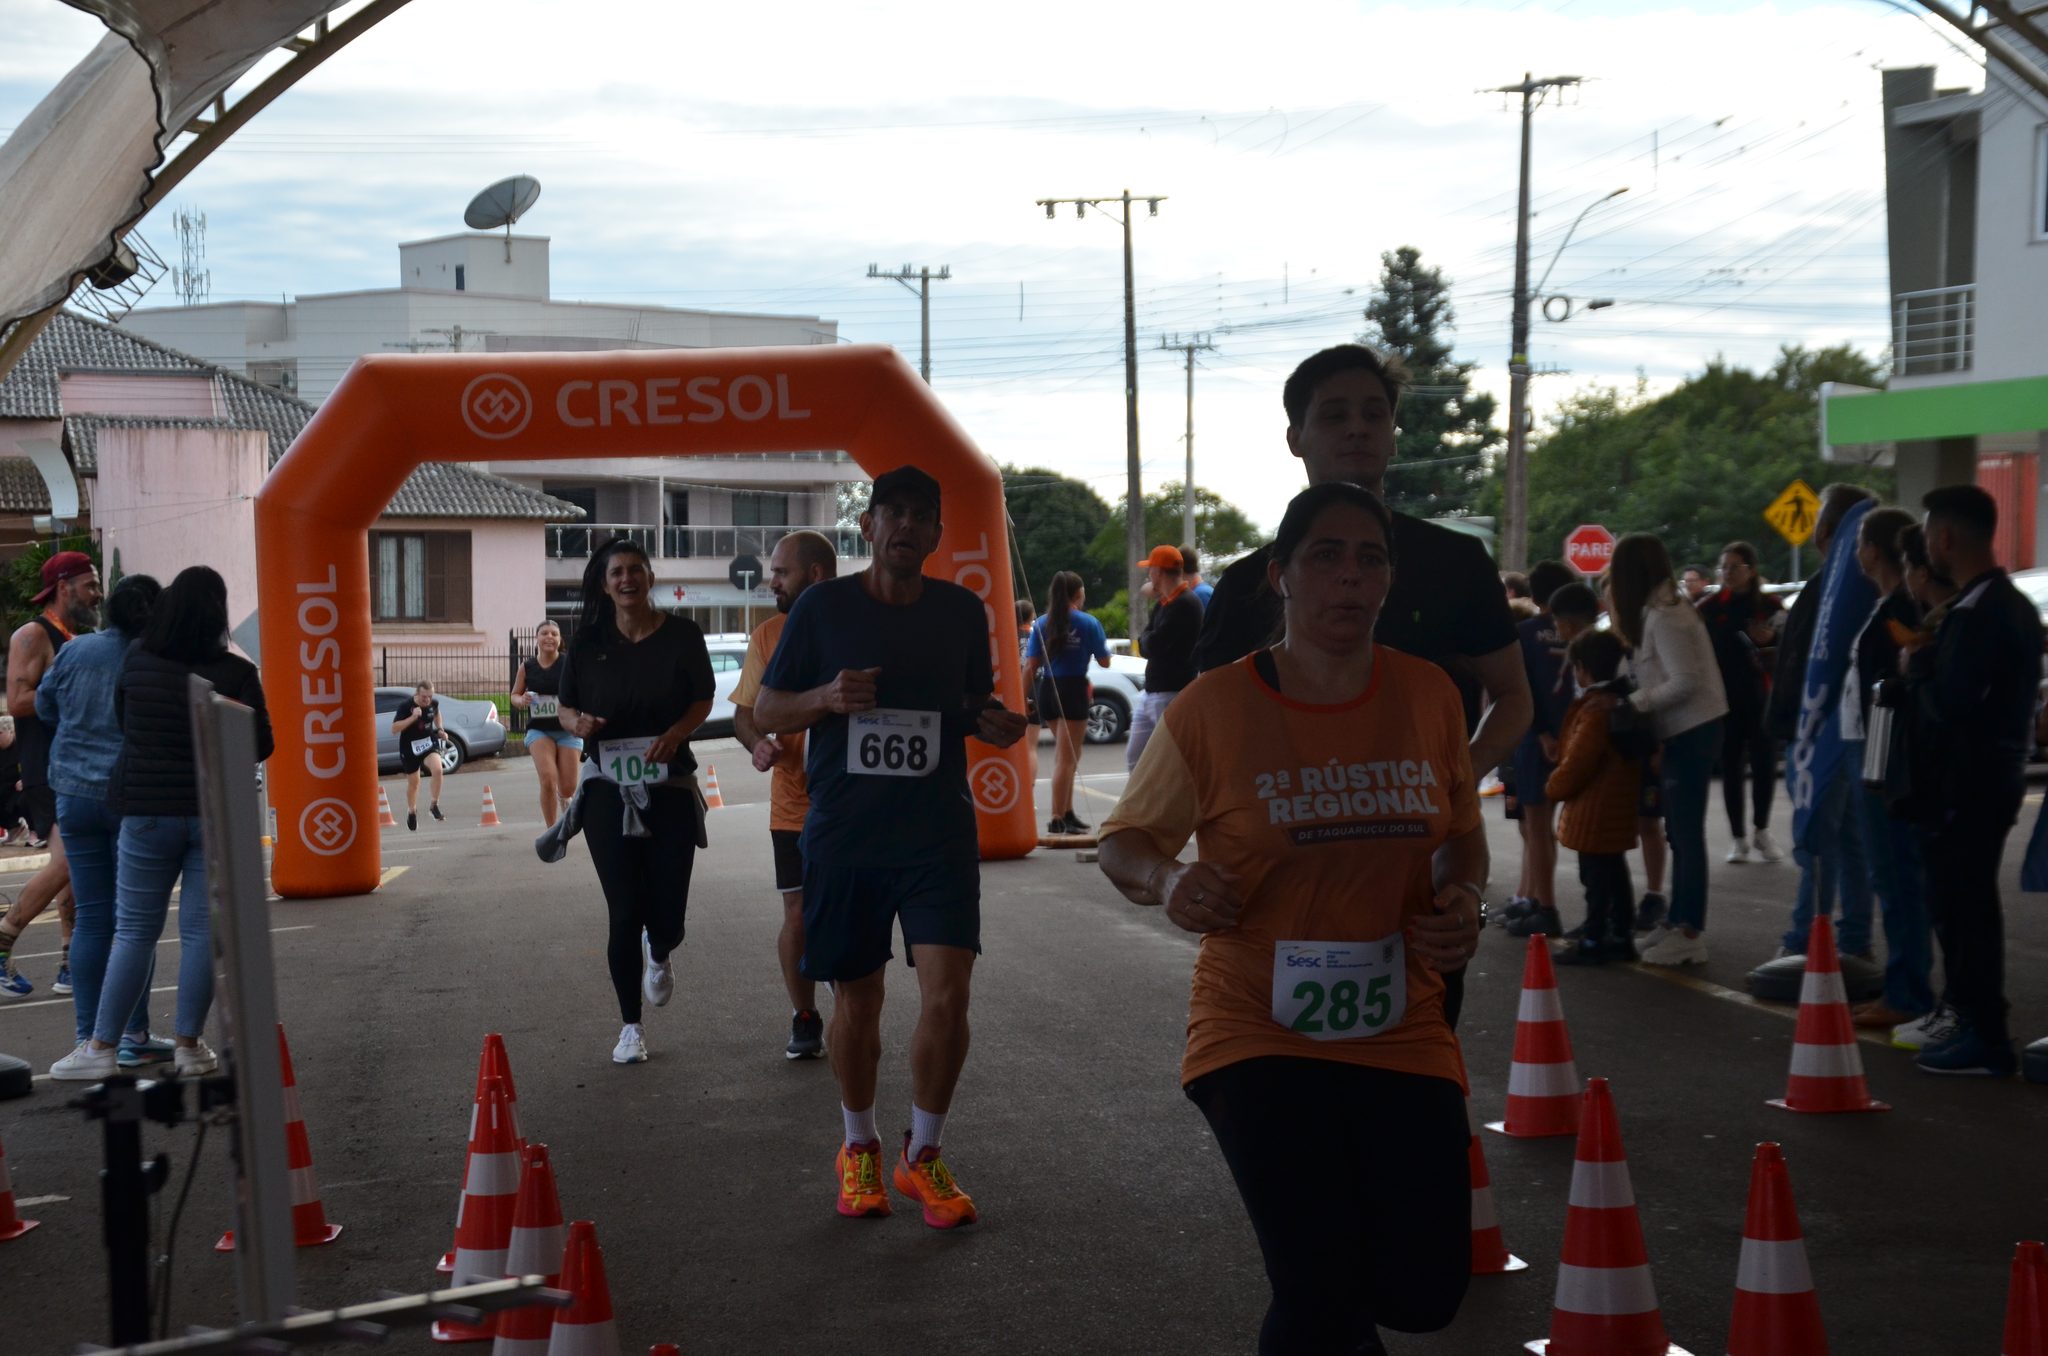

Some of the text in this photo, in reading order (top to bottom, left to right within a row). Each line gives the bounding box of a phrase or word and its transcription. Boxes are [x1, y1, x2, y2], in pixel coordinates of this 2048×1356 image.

[556, 373, 811, 428] CRESOL
[1568, 542, 1611, 556] PARE
[296, 563, 346, 780] CRESOL
[534, 702, 556, 715] 340
[611, 755, 660, 782] 104
[860, 733, 928, 771] 668
[1255, 757, 1438, 799] 2ª RÚSTICA
[1269, 787, 1440, 825] REGIONAL
[1298, 822, 1426, 841] DE TAQUARUÇU DO SUL
[1290, 974, 1392, 1032] 285
